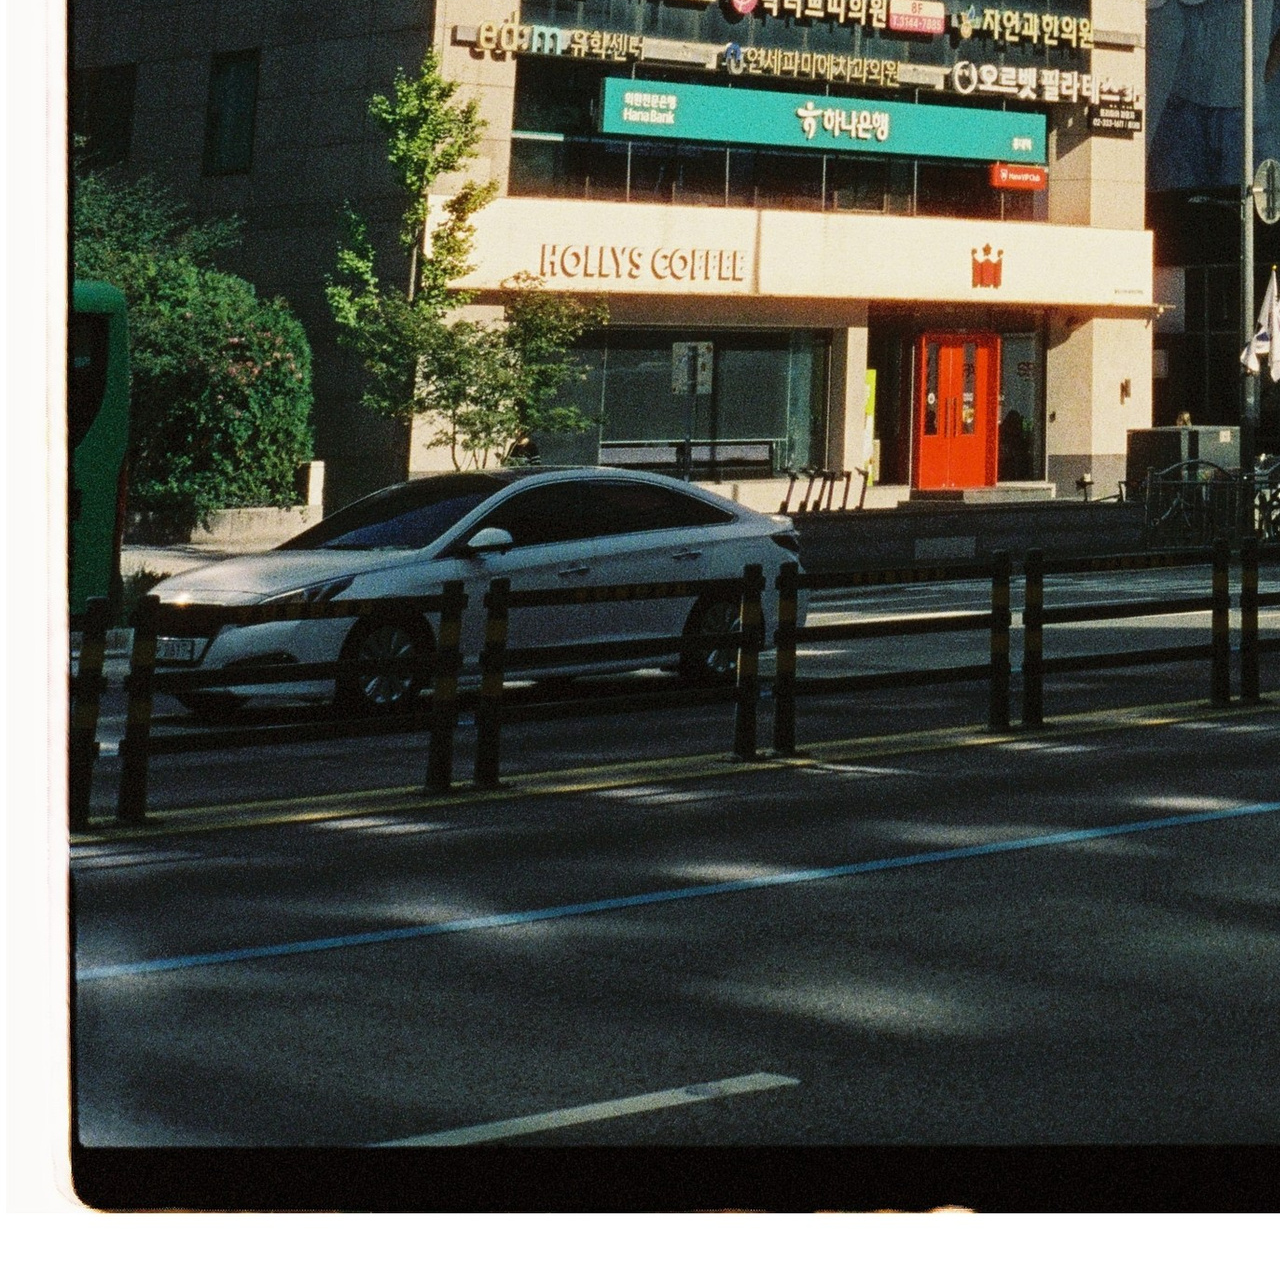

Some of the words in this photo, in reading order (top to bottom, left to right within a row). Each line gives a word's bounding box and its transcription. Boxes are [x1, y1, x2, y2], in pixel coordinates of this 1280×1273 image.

[911, 2, 924, 14] 8F
[571, 29, 646, 62] 유학센터
[982, 7, 1094, 51] 자연과한의원
[747, 47, 901, 87] 연세파미에치과의원
[977, 63, 1037, 101] 오르벳
[1040, 68, 1120, 105] 필라테스
[650, 110, 675, 124] Bank
[823, 108, 890, 141] 하나은행
[540, 244, 642, 279] HOLLYS
[651, 248, 744, 282] COFFEE
